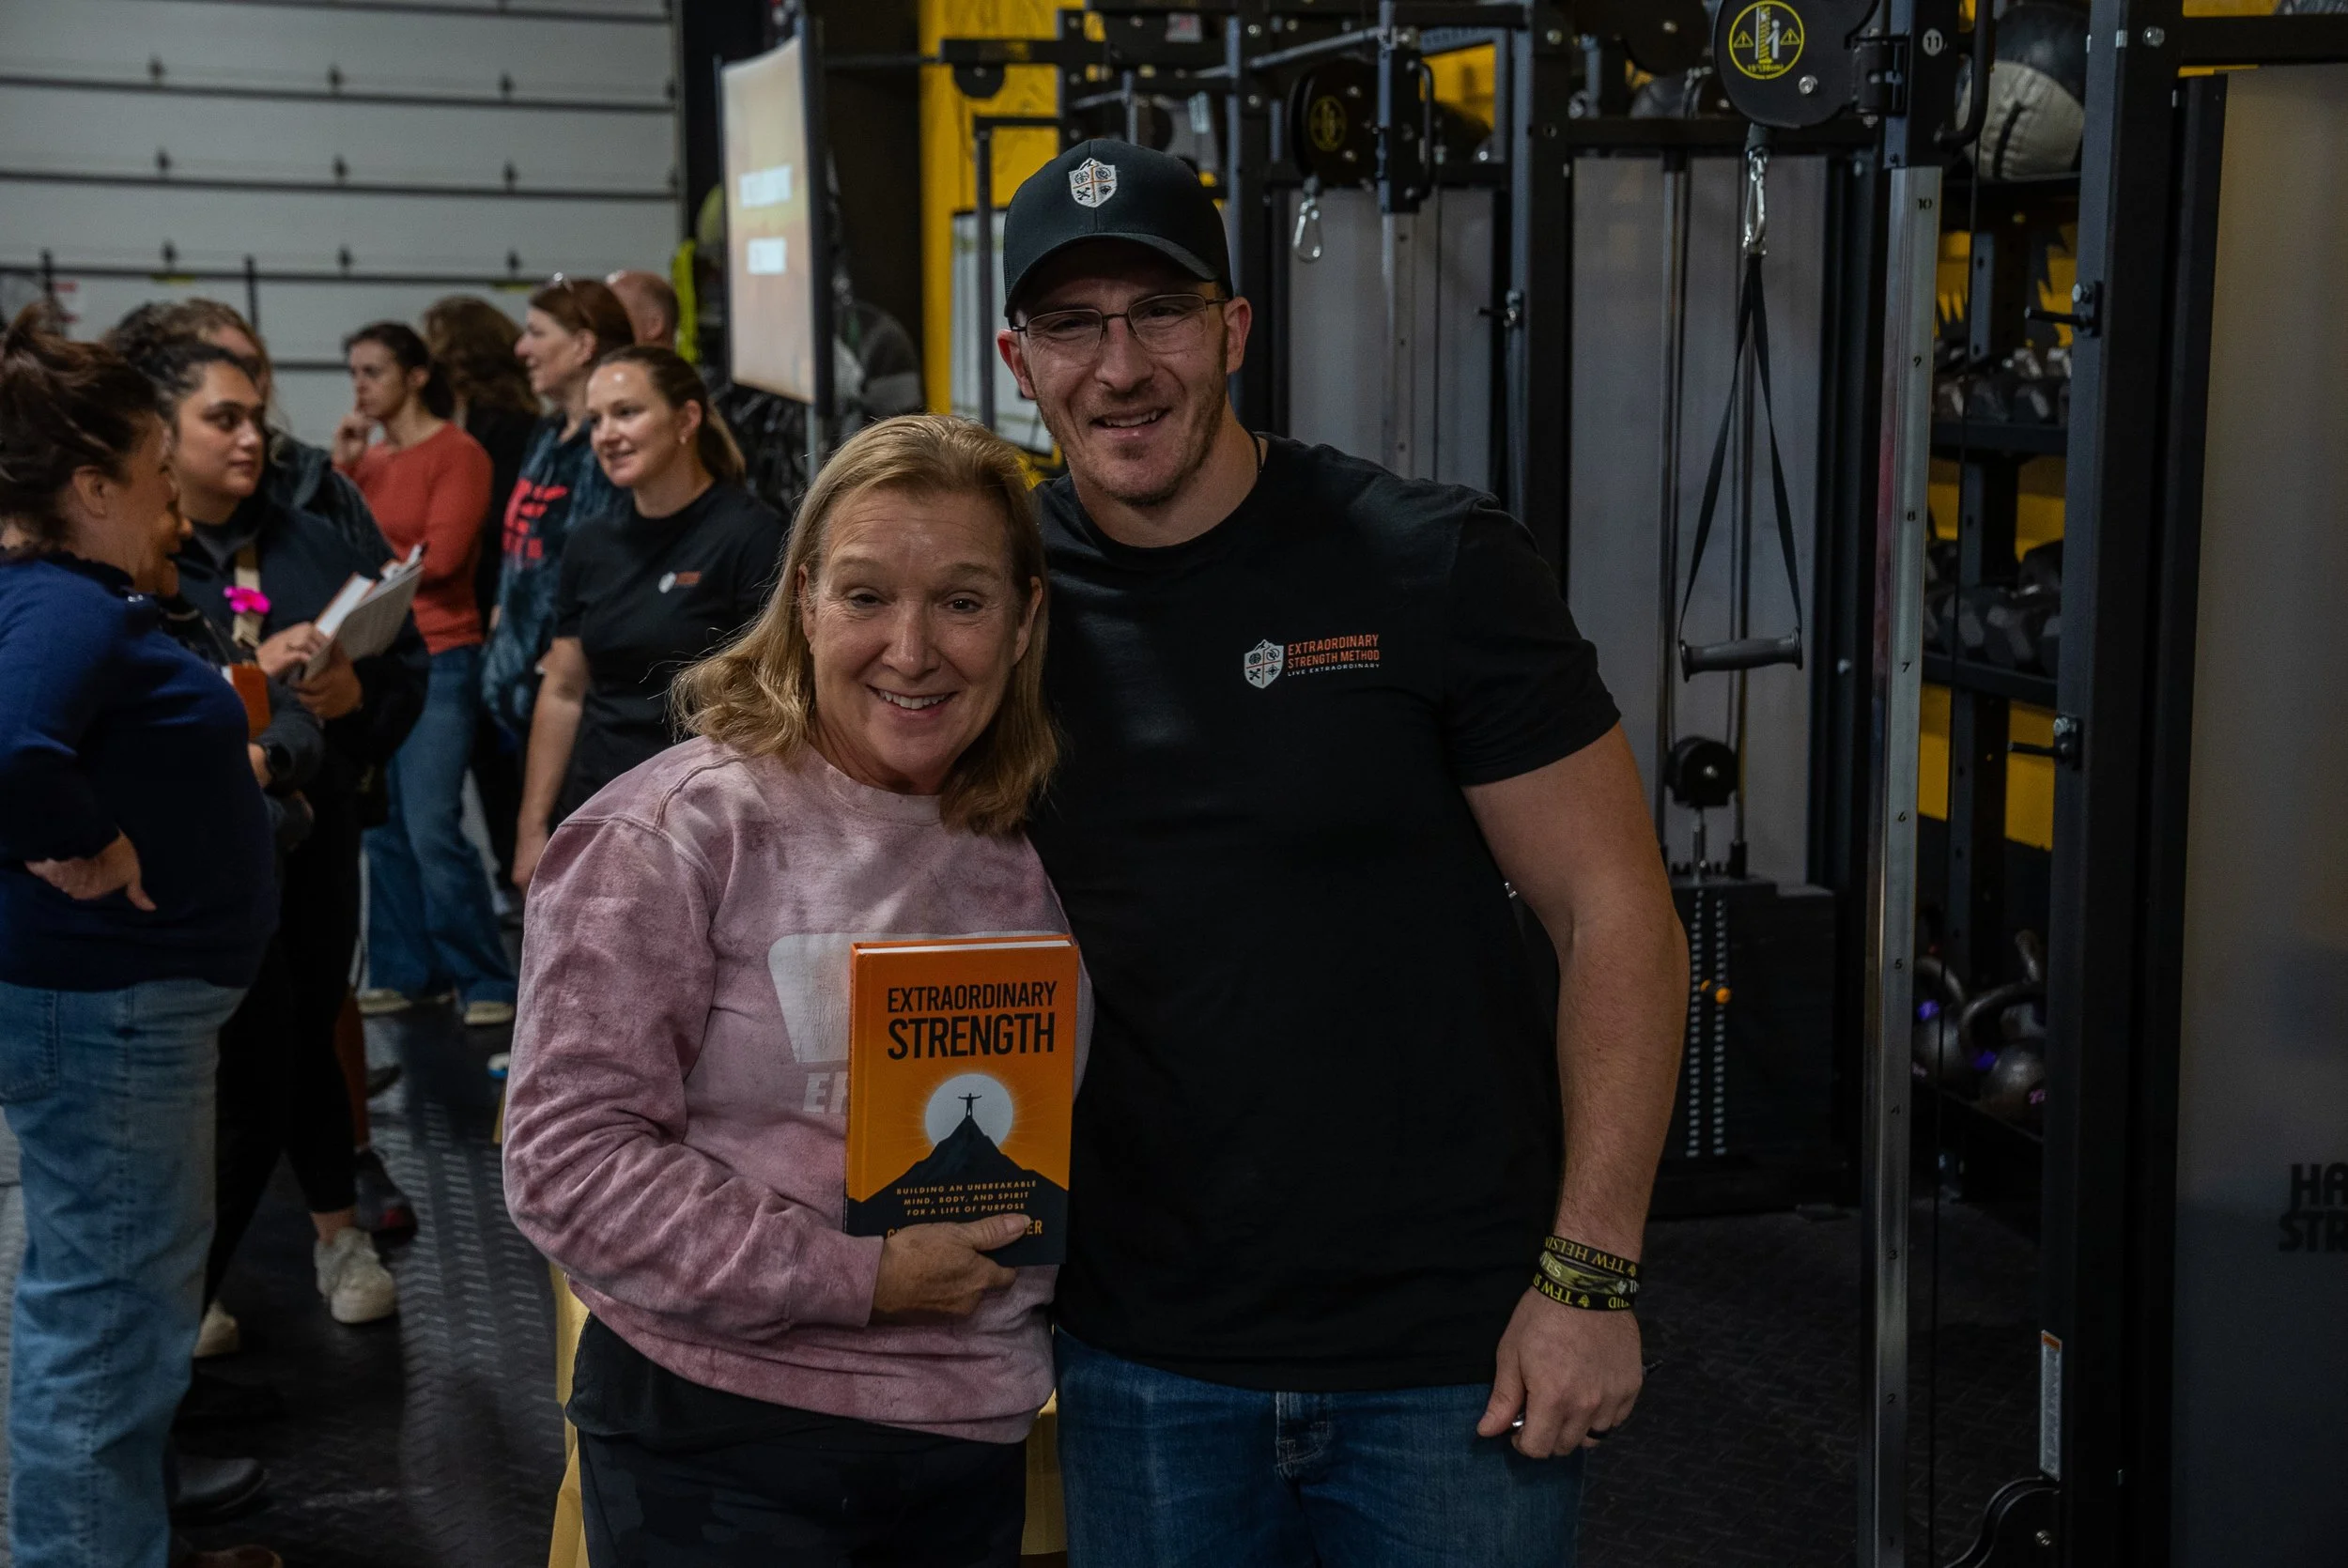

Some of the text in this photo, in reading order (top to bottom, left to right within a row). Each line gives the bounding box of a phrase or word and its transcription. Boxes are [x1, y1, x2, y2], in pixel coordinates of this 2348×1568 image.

[1927, 37, 1939, 48] 11
[1918, 198, 1933, 209] 10
[1913, 356, 1922, 367] 9
[1288, 634, 1380, 655] EXTRAORDINARY
[1288, 649, 1380, 669] STRENGTH METHOD
[1309, 663, 1381, 674] EXTRAORDINARY
[1902, 662, 1909, 673] 7
[1898, 811, 1906, 822] 6
[1895, 959, 1903, 969] 5
[887, 981, 1058, 1013] EXTRAORDINARY
[888, 1012, 1055, 1060] STRENGTH
[896, 1186, 945, 1195] BUILDING
[967, 1180, 1037, 1191] UNBREAKABLE
[973, 1193, 994, 1202] AND
[997, 1191, 1029, 1201] SPIRIT
[906, 1208, 926, 1217] FOR
[940, 1207, 960, 1215] LIFE
[965, 1205, 977, 1213] OF
[981, 1203, 1026, 1212] PURPOSE
[1888, 1393, 1896, 1404] 2
